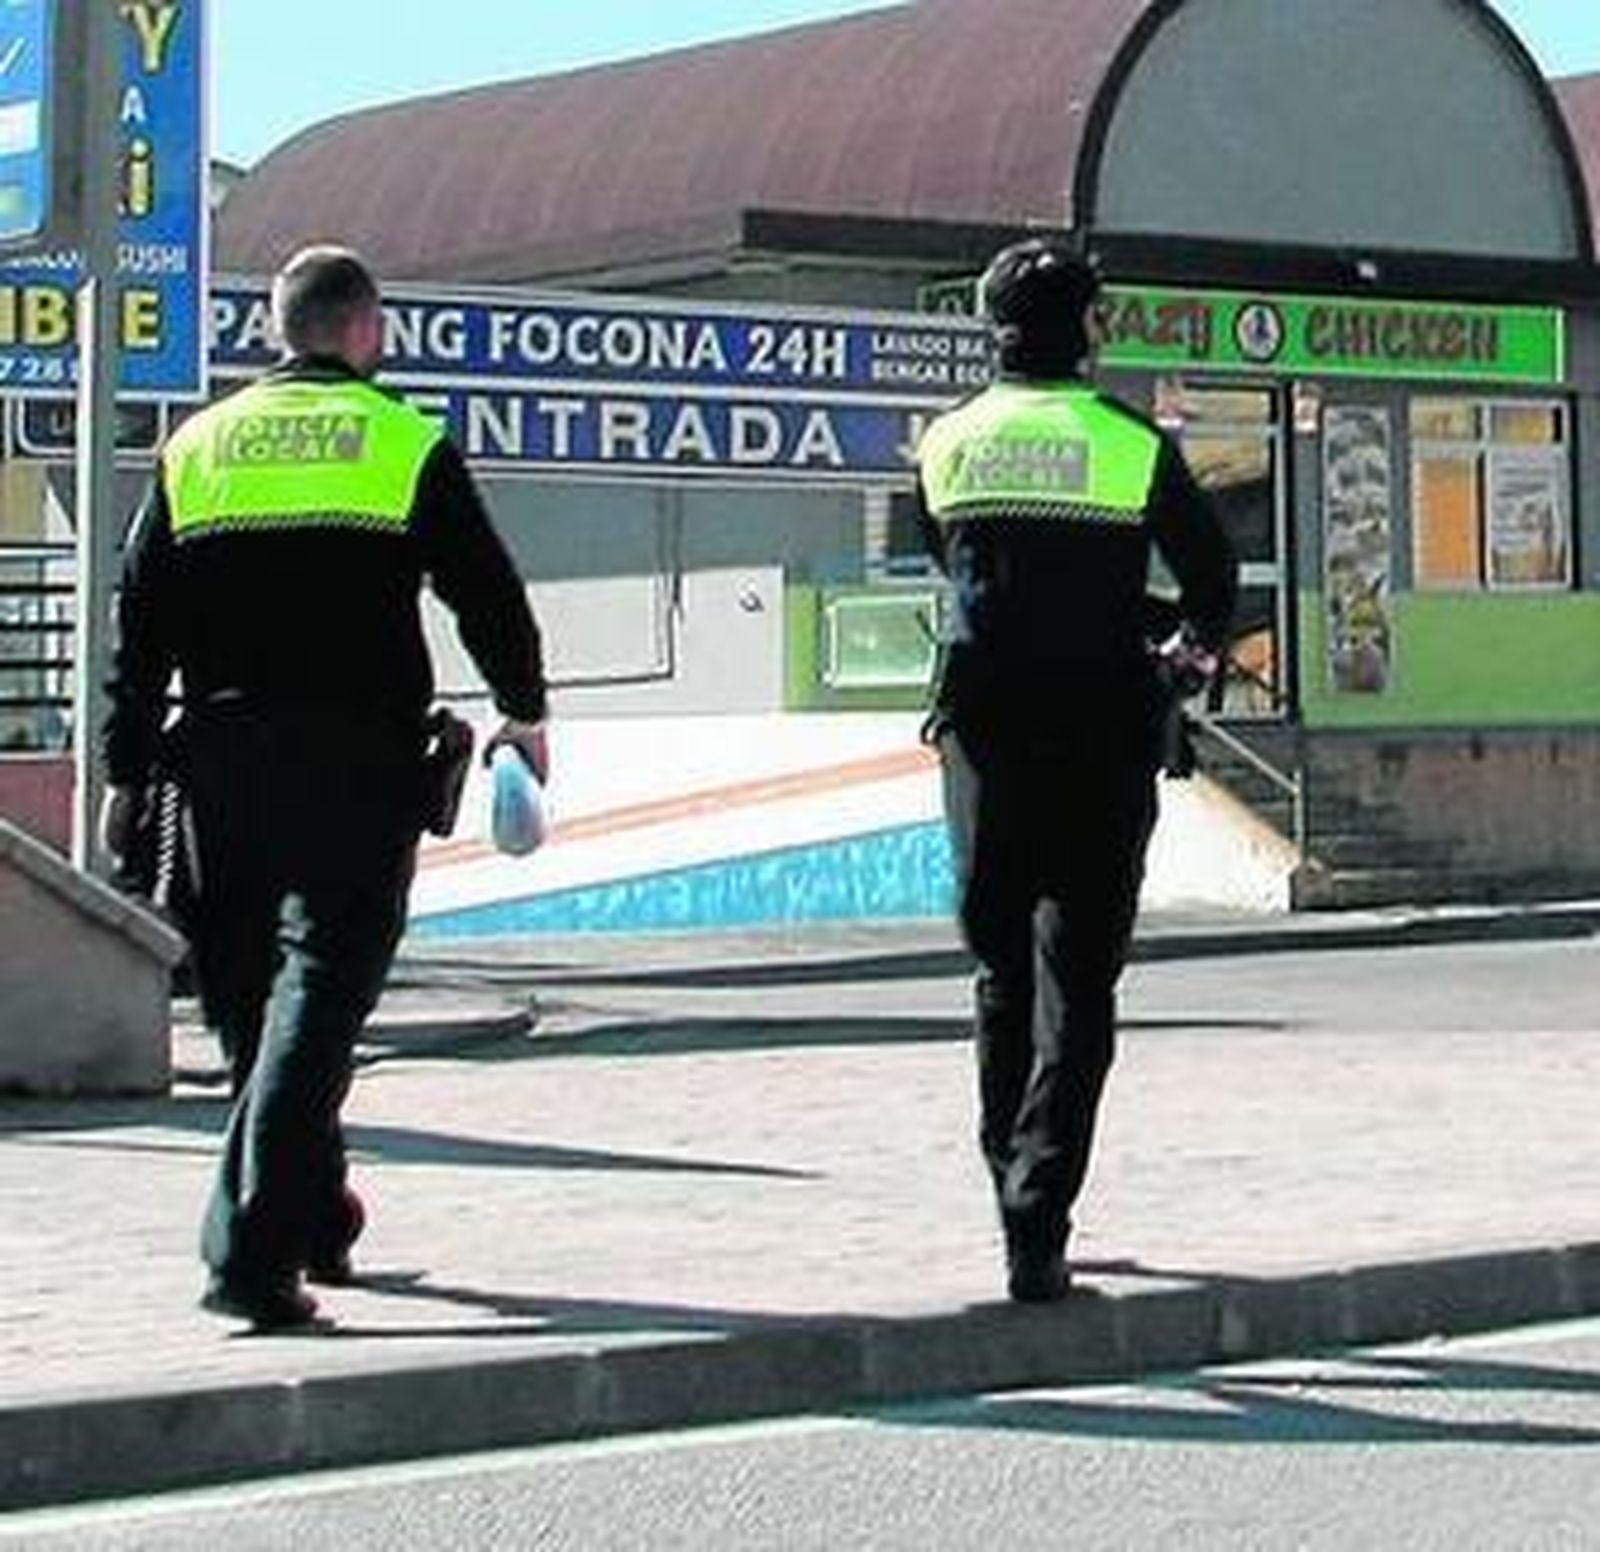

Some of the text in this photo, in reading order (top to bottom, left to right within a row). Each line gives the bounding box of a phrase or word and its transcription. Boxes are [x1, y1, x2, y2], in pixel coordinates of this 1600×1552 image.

[208, 301, 847, 378] PANG FOCONA 24H
